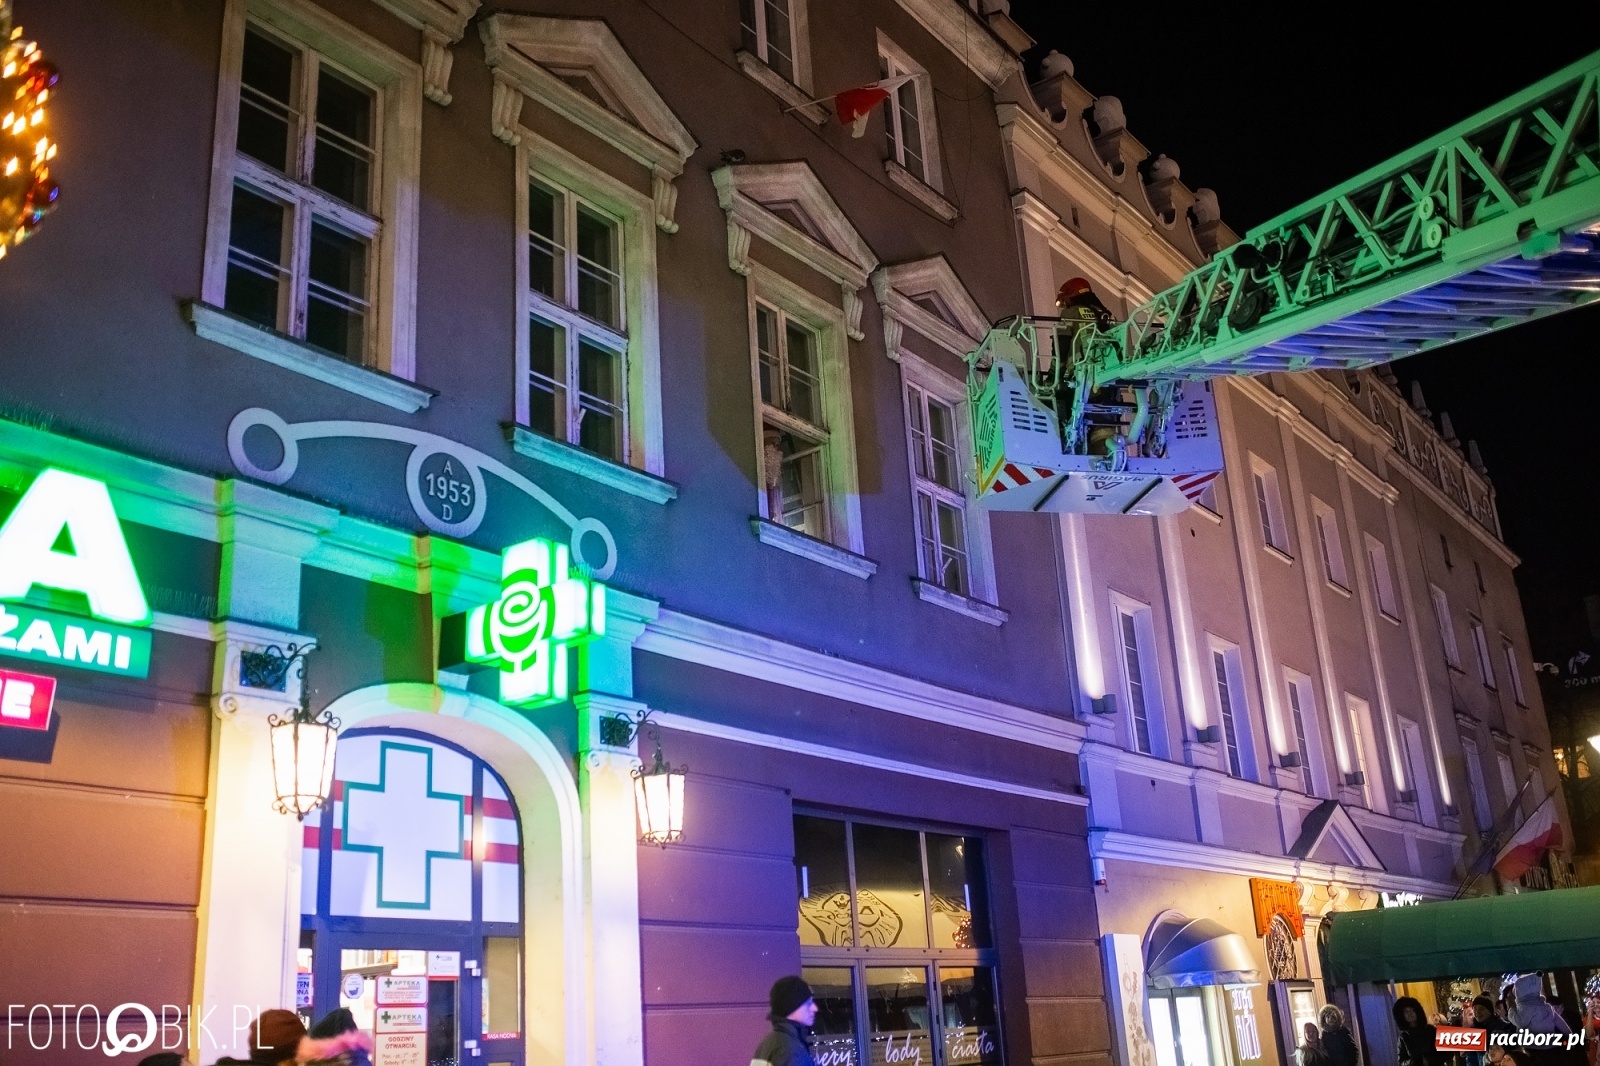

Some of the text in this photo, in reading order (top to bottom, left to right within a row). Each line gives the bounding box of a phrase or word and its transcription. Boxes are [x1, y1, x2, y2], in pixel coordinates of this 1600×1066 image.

[986, 412, 998, 470] MAGIRUS
[443, 459, 454, 476] A
[1080, 474, 1145, 482] MAGIRUS
[425, 472, 472, 507] 1953
[441, 503, 453, 521] D
[0, 678, 36, 720] E
[885, 1031, 923, 1066] lody
[951, 1029, 996, 1059] ciasta
